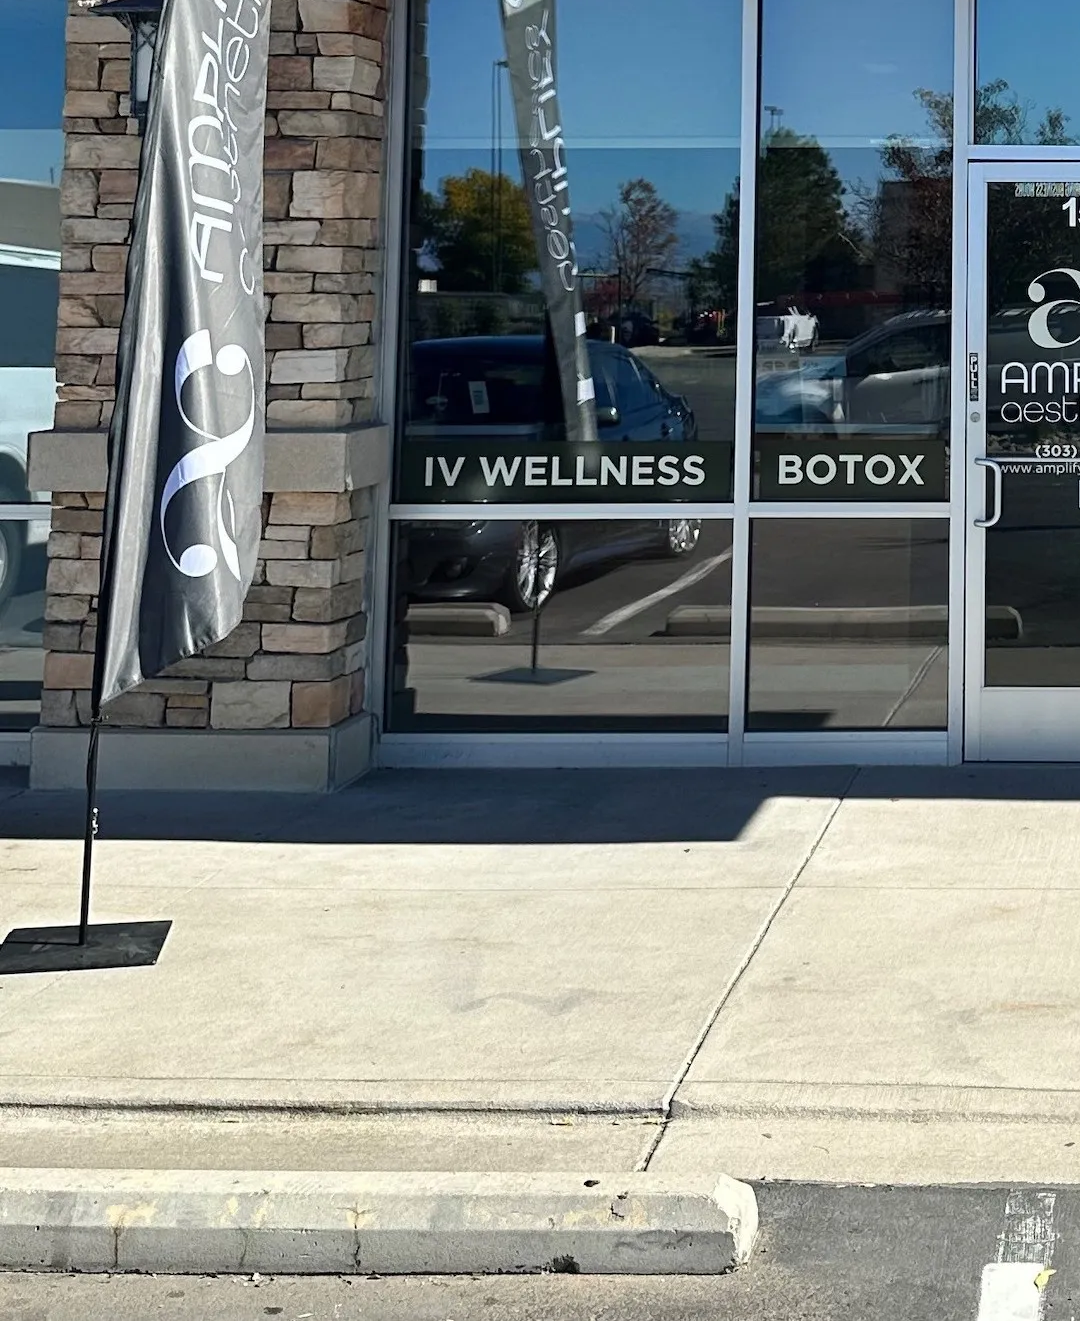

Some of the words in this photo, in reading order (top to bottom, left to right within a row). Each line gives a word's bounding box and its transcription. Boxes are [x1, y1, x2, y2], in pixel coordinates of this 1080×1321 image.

[970, 356, 978, 389] PULL
[1035, 444, 1078, 459] (303)
[424, 456, 466, 487] IV
[479, 455, 706, 487] WELLNESS
[778, 454, 925, 486] BOTOX
